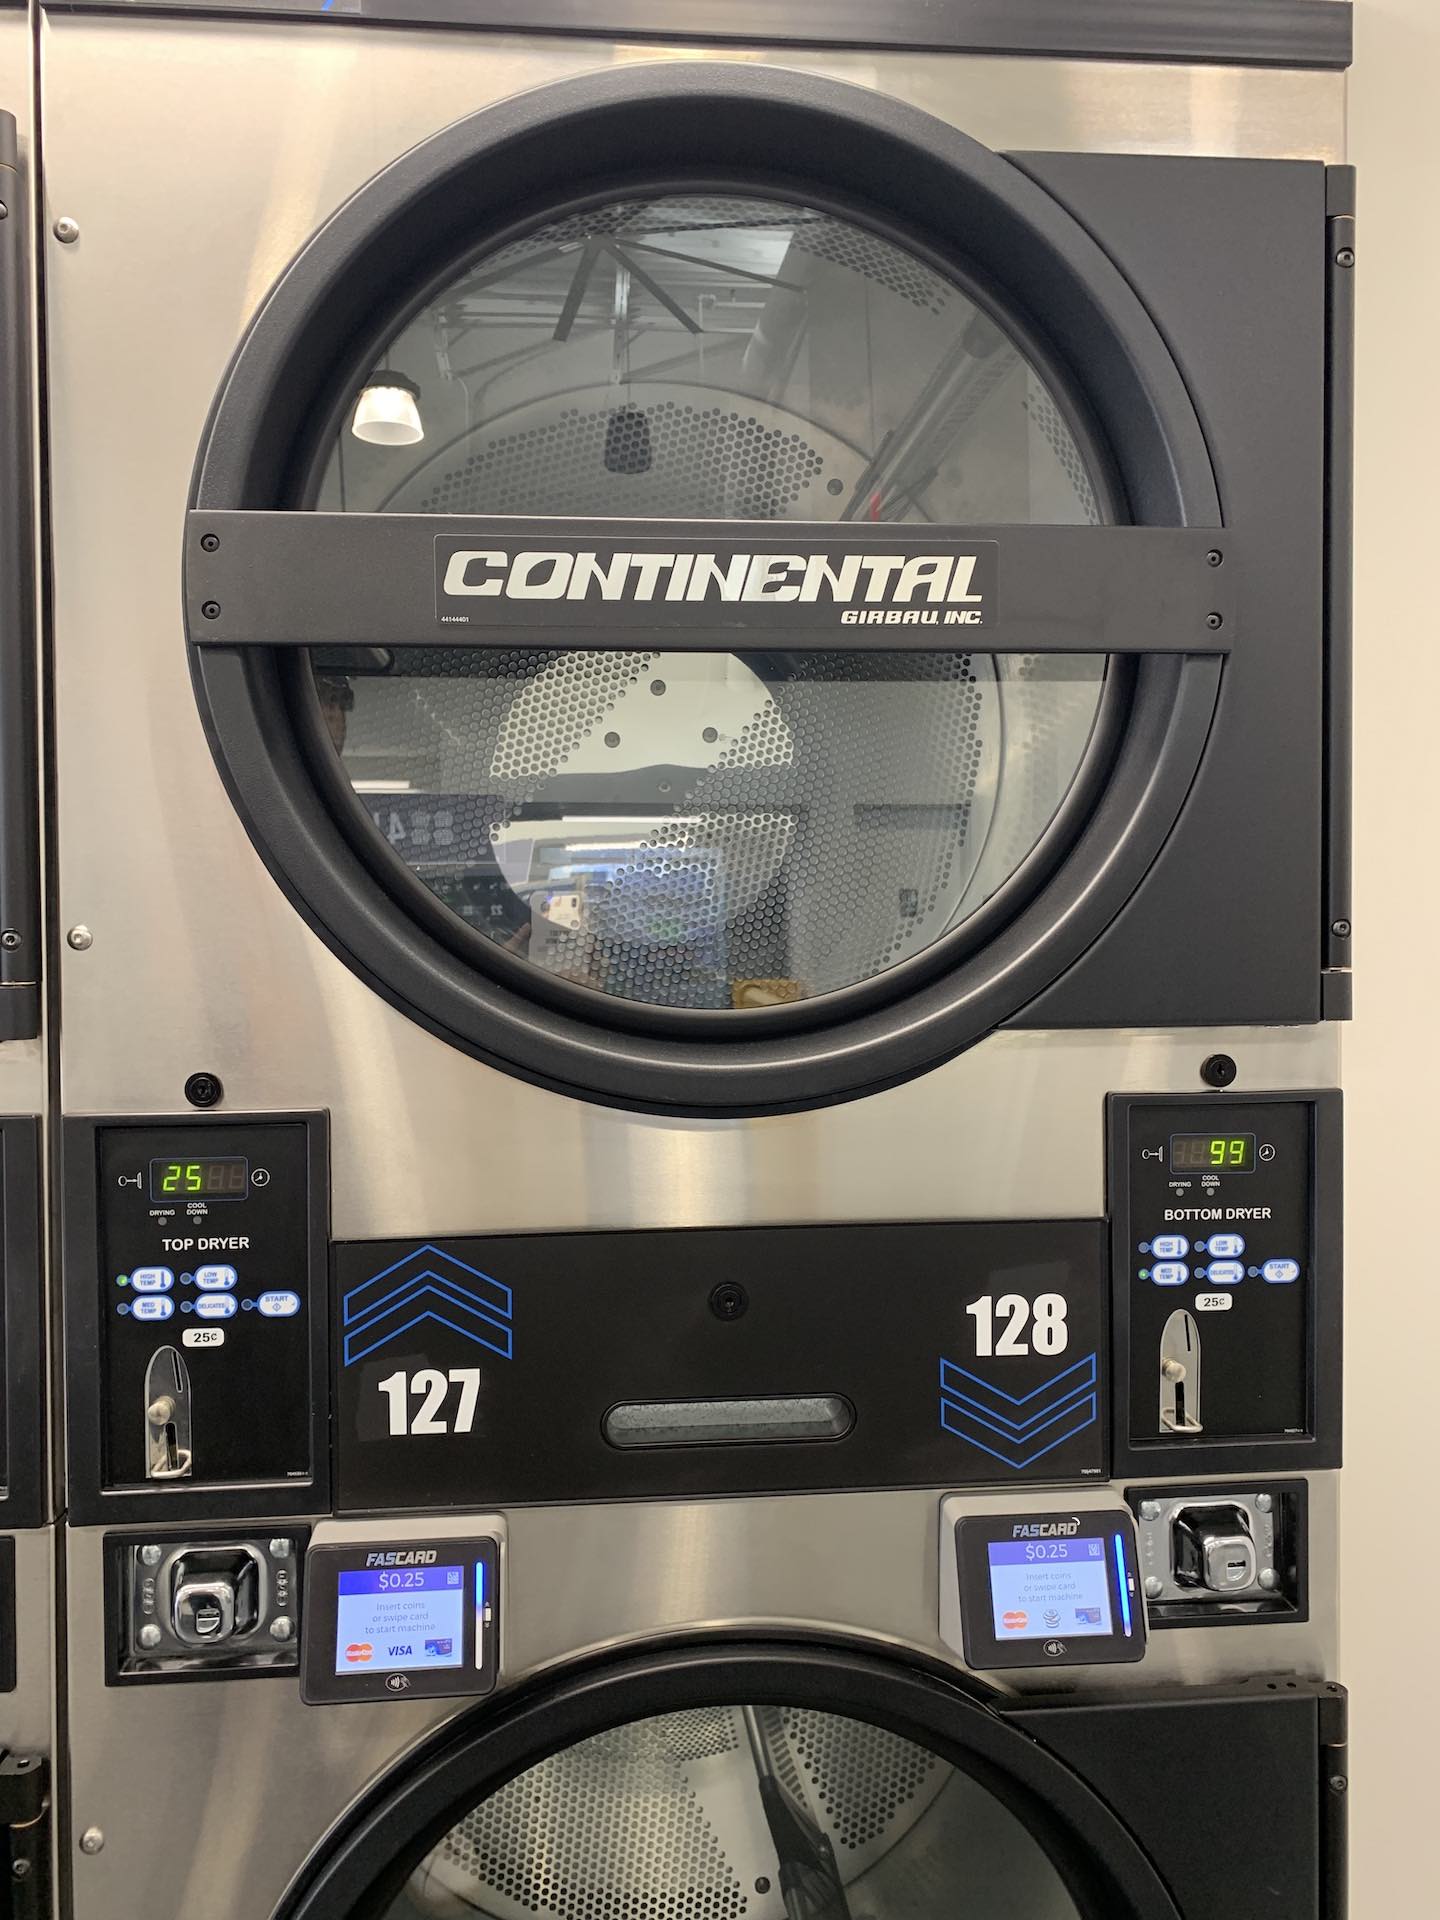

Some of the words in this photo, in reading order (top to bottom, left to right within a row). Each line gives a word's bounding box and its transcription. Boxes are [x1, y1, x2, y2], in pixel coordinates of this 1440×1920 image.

[442, 549, 983, 603] CONTINENTAL
[840, 609, 940, 625] GIRBAU,
[944, 609, 983, 624] INC.
[1211, 1140, 1245, 1165] 99
[163, 1165, 202, 1192] 25
[1164, 1208, 1222, 1221] BOTTOM
[1225, 1207, 1271, 1220] DRYER
[162, 1238, 194, 1251] TOP
[198, 1236, 250, 1250] DRYER
[966, 1293, 1068, 1357] 128
[378, 1367, 482, 1436] 127
[1012, 1522, 1078, 1538] FASCARD
[366, 1550, 437, 1567] FASCARD
[1025, 1543, 1068, 1561] $0.25
[379, 1571, 425, 1590] $0.25
[1026, 1571, 1048, 1581] Insert
[1050, 1571, 1071, 1580] coins
[1023, 1583, 1032, 1591] or
[1034, 1582, 1057, 1592] swipe
[1059, 1581, 1077, 1591] card
[1018, 1594, 1027, 1602] to
[1028, 1593, 1047, 1602] start
[1048, 1591, 1083, 1601] machine
[376, 1602, 401, 1611] Insert
[403, 1601, 425, 1610] coins
[372, 1614, 382, 1622] or
[383, 1612, 408, 1623] swipe
[409, 1612, 429, 1621] card
[365, 1626, 375, 1634] to
[376, 1624, 396, 1634] start
[397, 1622, 436, 1632] machine
[388, 1645, 412, 1656] VISA
